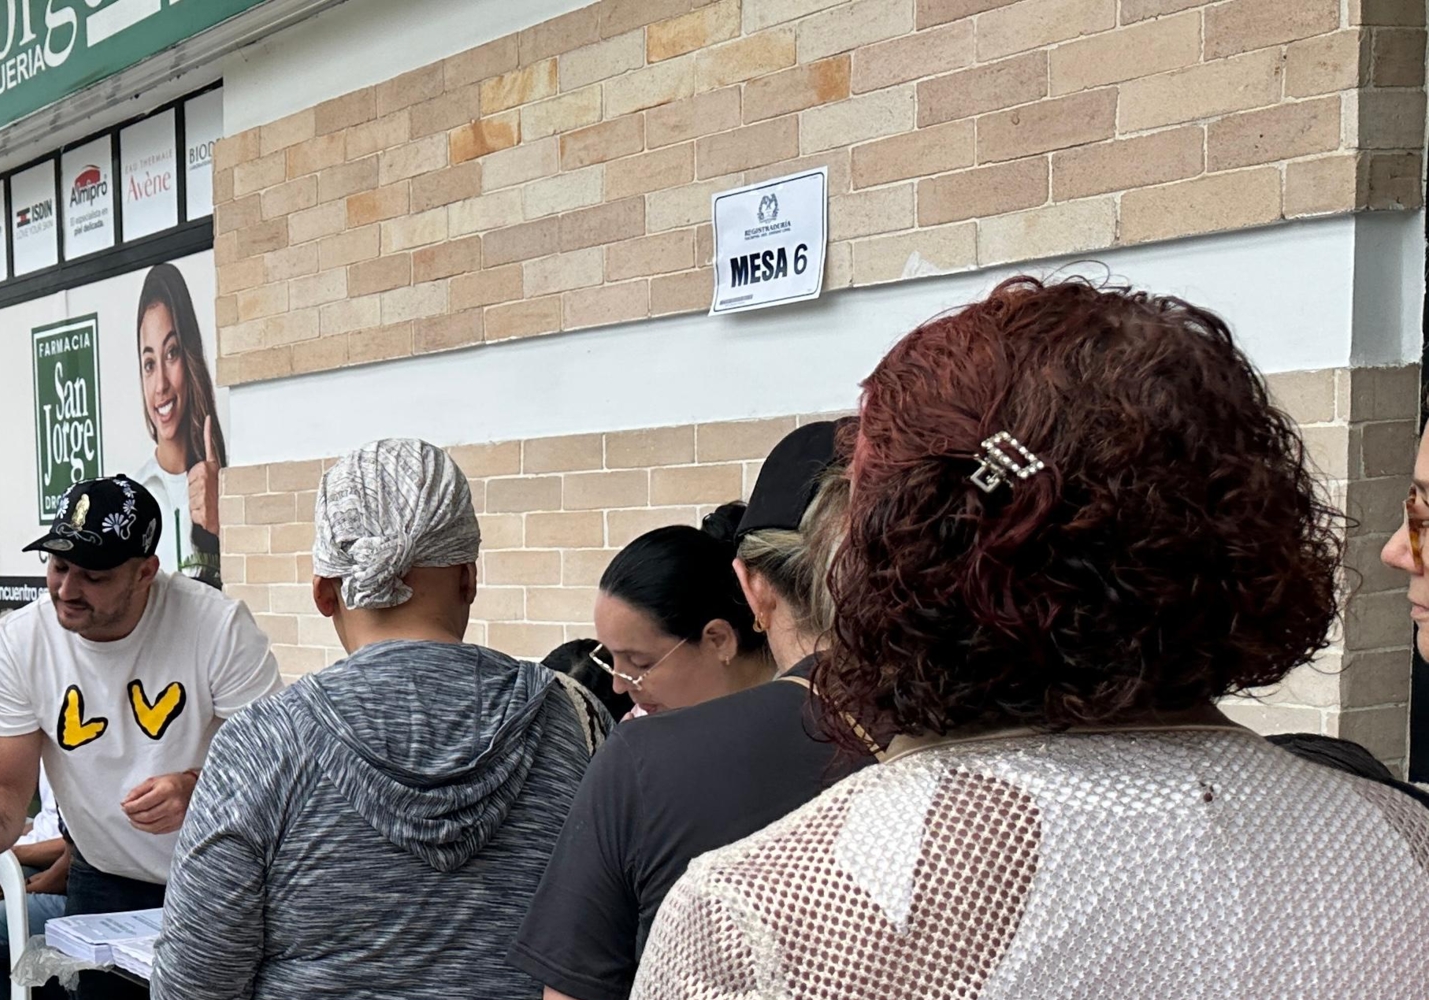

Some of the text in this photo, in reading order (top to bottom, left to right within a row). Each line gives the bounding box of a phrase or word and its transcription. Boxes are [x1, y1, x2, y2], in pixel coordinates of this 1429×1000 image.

[140, 149, 174, 169] THERMALE
[127, 171, 171, 204] Avène
[32, 199, 53, 222] ISDIN
[730, 243, 808, 288] MESA 6
[39, 332, 91, 358] FARMACIA
[54, 361, 89, 421] San
[43, 404, 95, 486] Jorge
